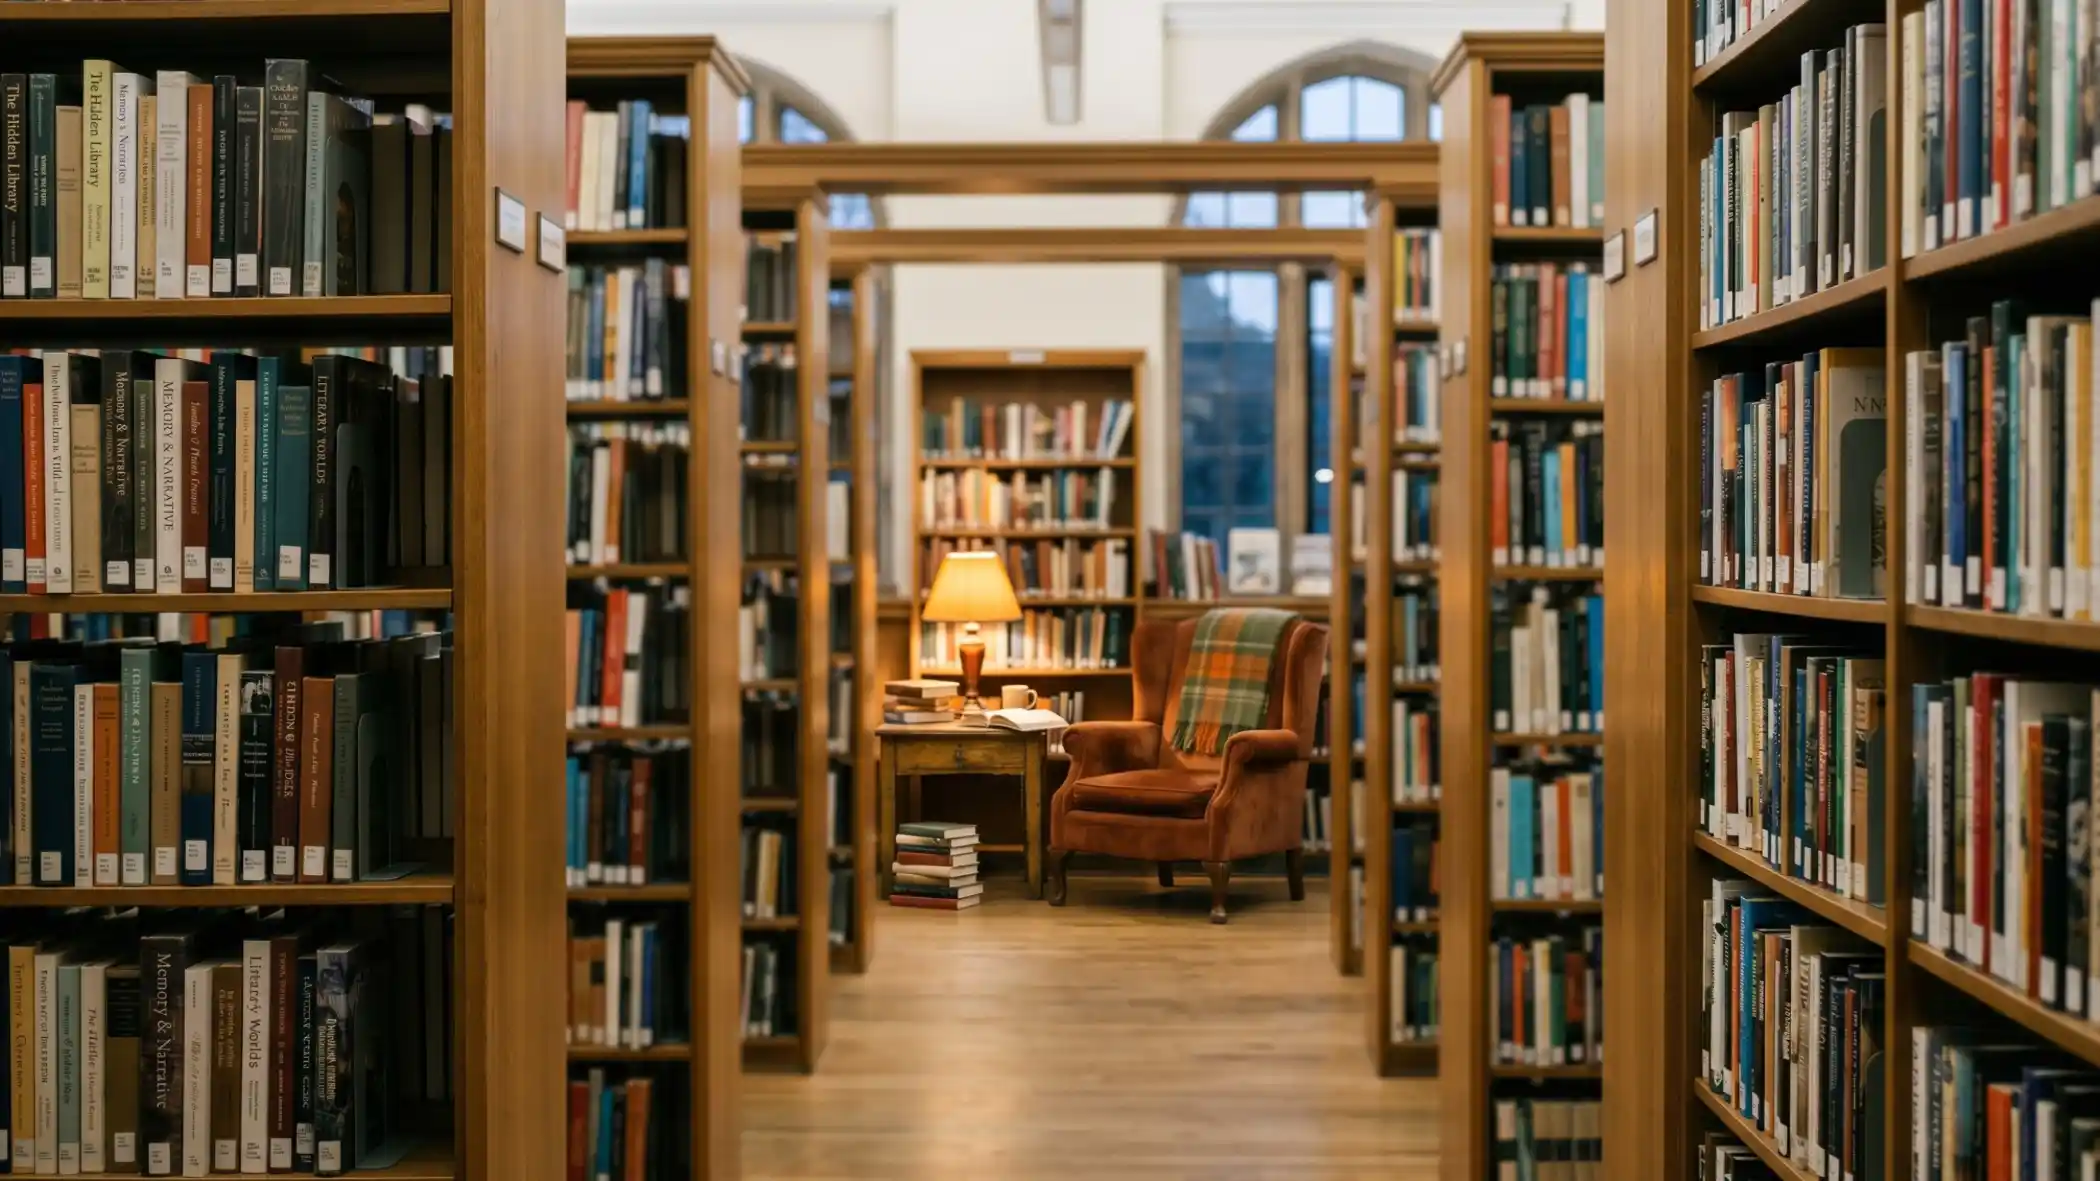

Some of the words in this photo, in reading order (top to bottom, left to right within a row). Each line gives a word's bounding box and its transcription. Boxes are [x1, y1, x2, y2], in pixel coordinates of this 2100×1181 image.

[7, 83, 20, 109] The
[7, 113, 20, 160] Hidden
[5, 163, 20, 213] Library
[87, 142, 103, 189] Library
[116, 423, 129, 433] &
[162, 380, 174, 439] MEMORY
[163, 443, 174, 453] &
[163, 456, 174, 532] NARRATIVE
[154, 953, 171, 1016] Memory
[157, 1020, 172, 1034] &
[249, 1019, 262, 1069] Worlds
[156, 1039, 171, 1109] Narrative
